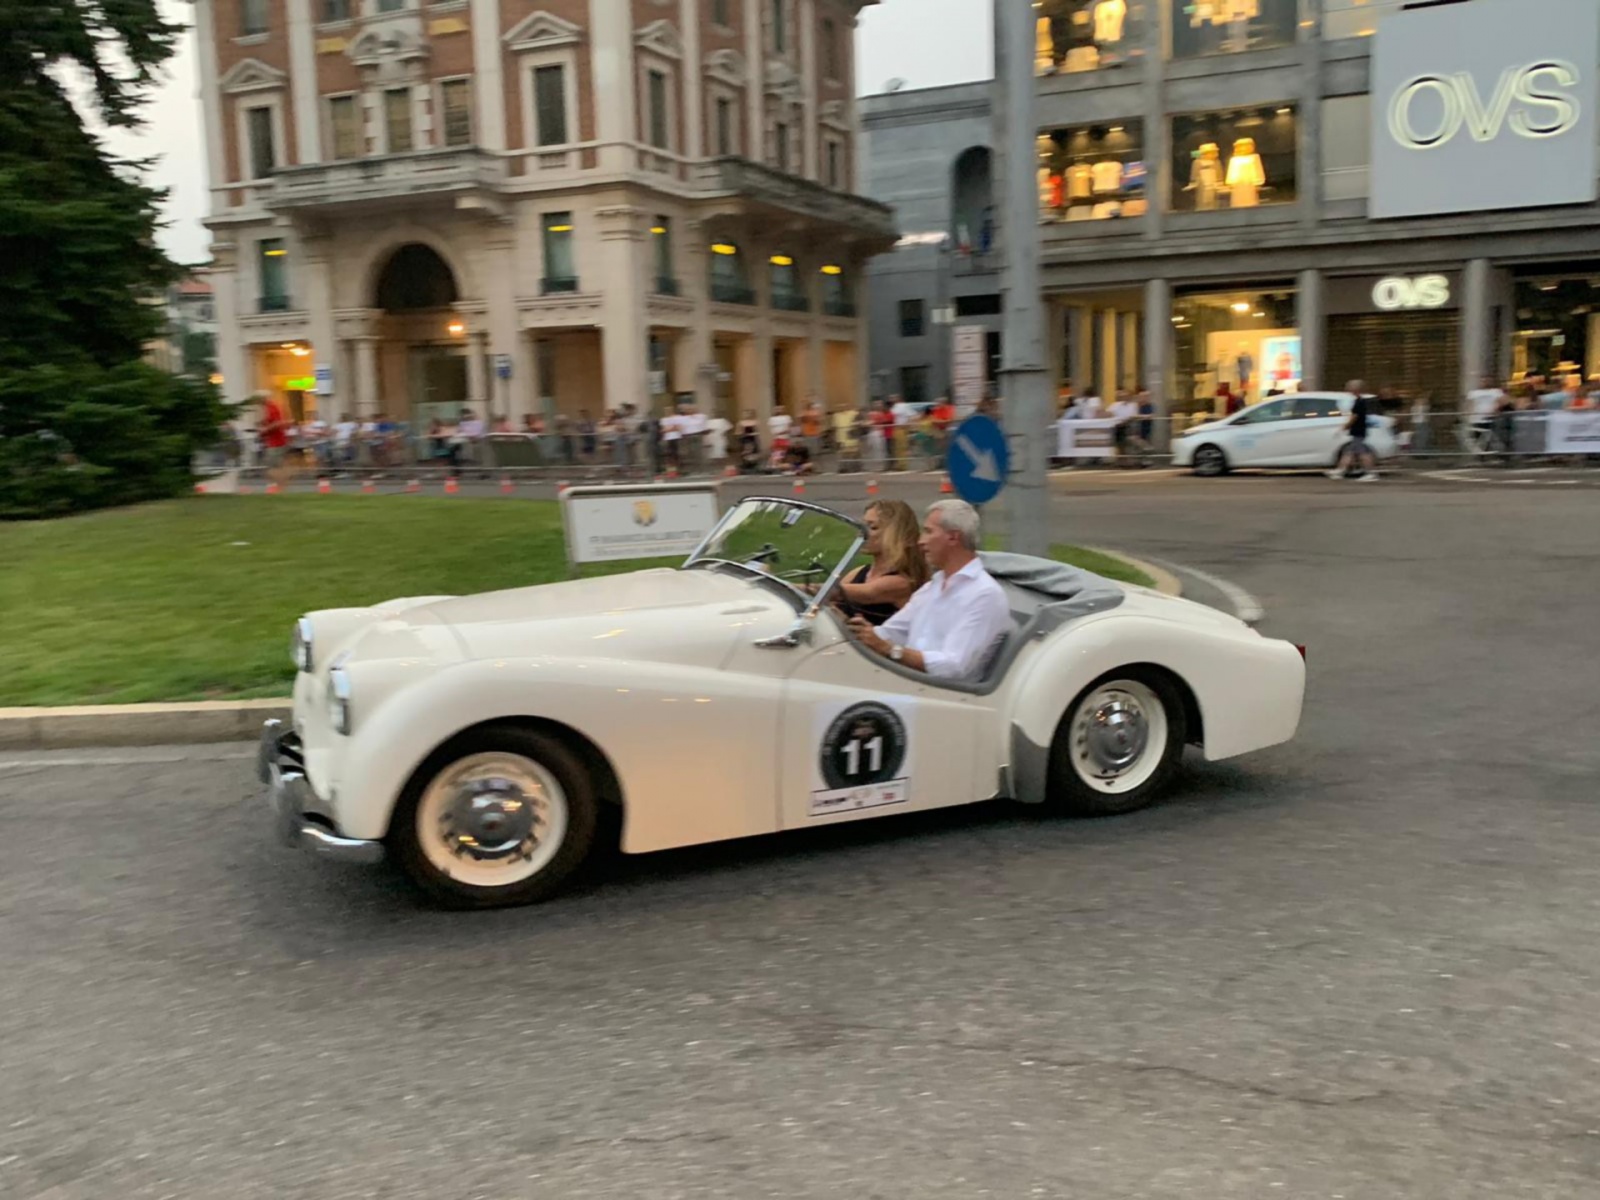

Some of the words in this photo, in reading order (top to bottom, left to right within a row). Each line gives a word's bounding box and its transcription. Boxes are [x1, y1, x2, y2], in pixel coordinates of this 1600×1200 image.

[1388, 60, 1580, 149] OVS
[1372, 275, 1449, 307] OVS
[841, 737, 883, 775] 11
